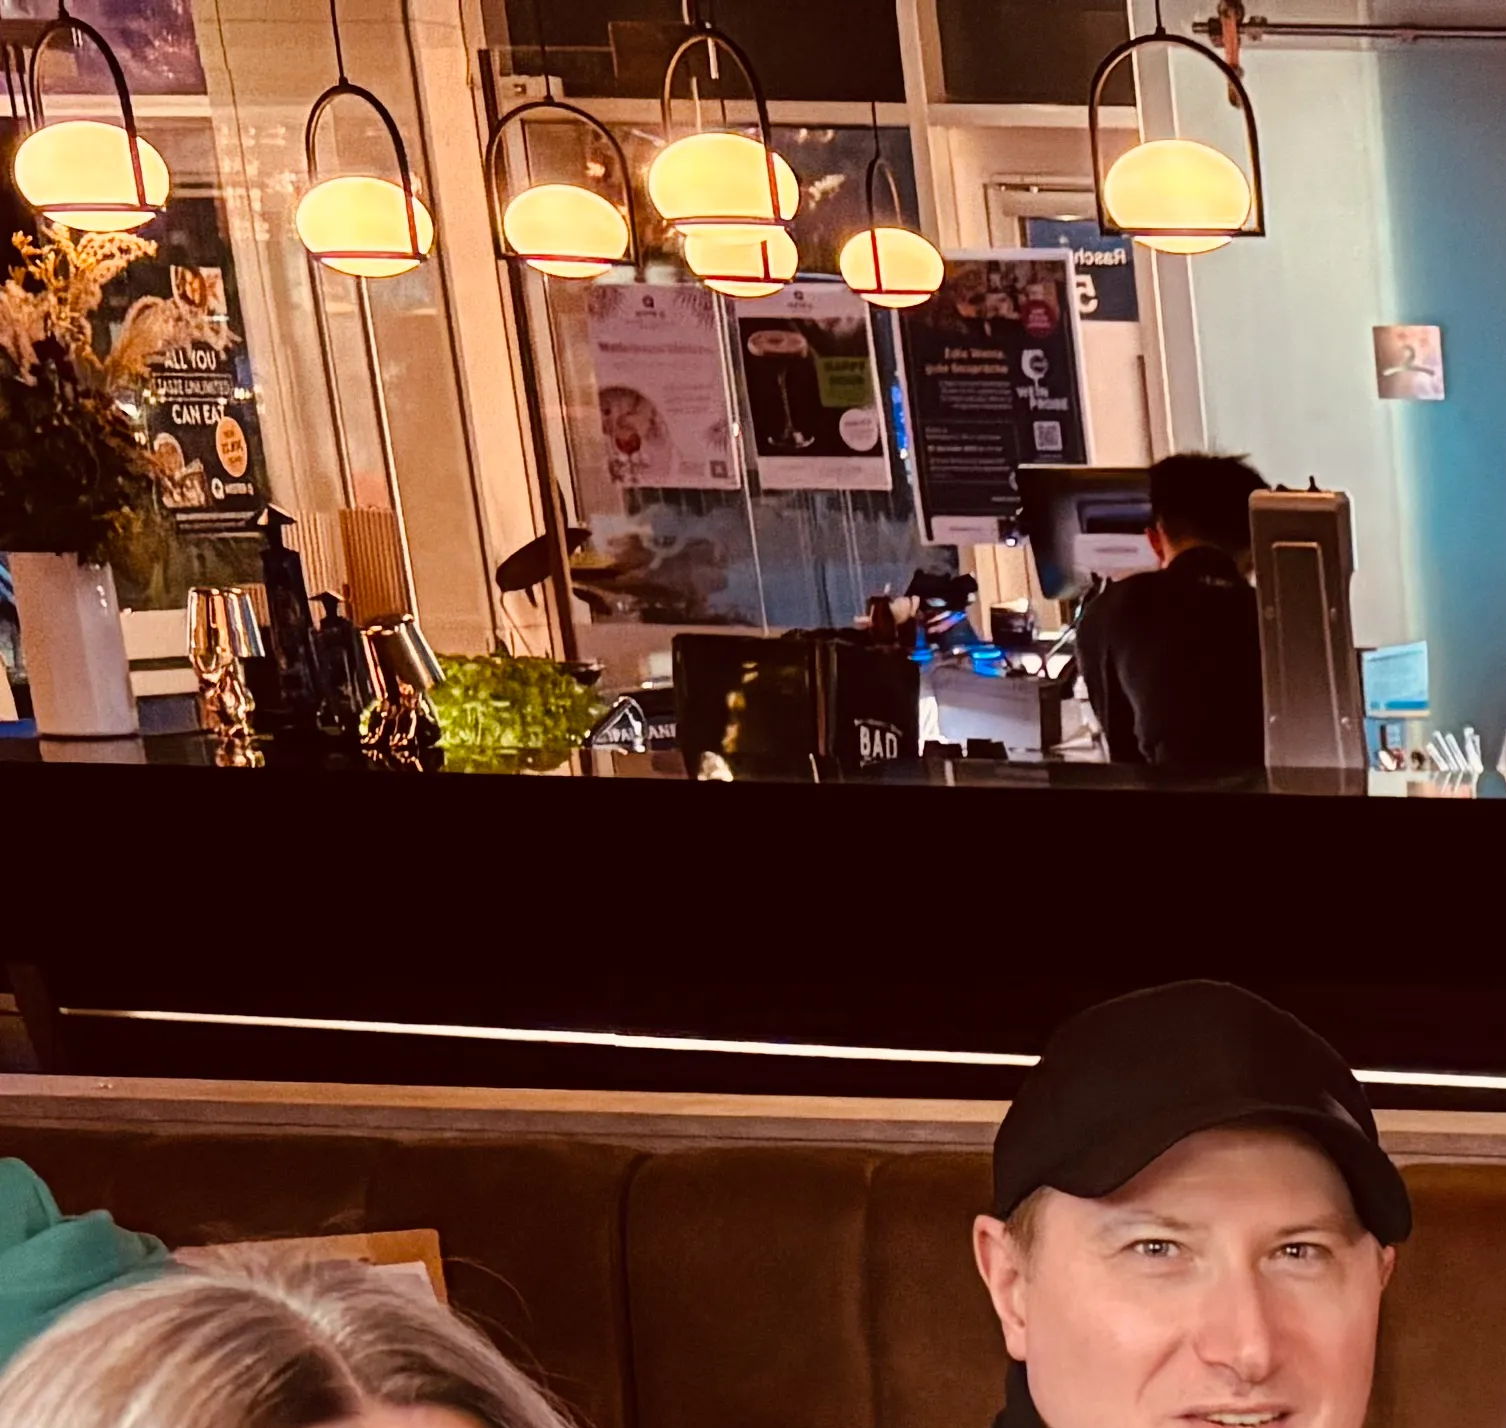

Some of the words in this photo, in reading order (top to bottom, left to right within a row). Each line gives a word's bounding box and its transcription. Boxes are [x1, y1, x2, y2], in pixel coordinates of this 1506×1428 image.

[191, 350, 217, 371] YOU
[172, 403, 201, 425] CAN
[203, 404, 226, 425] EAT
